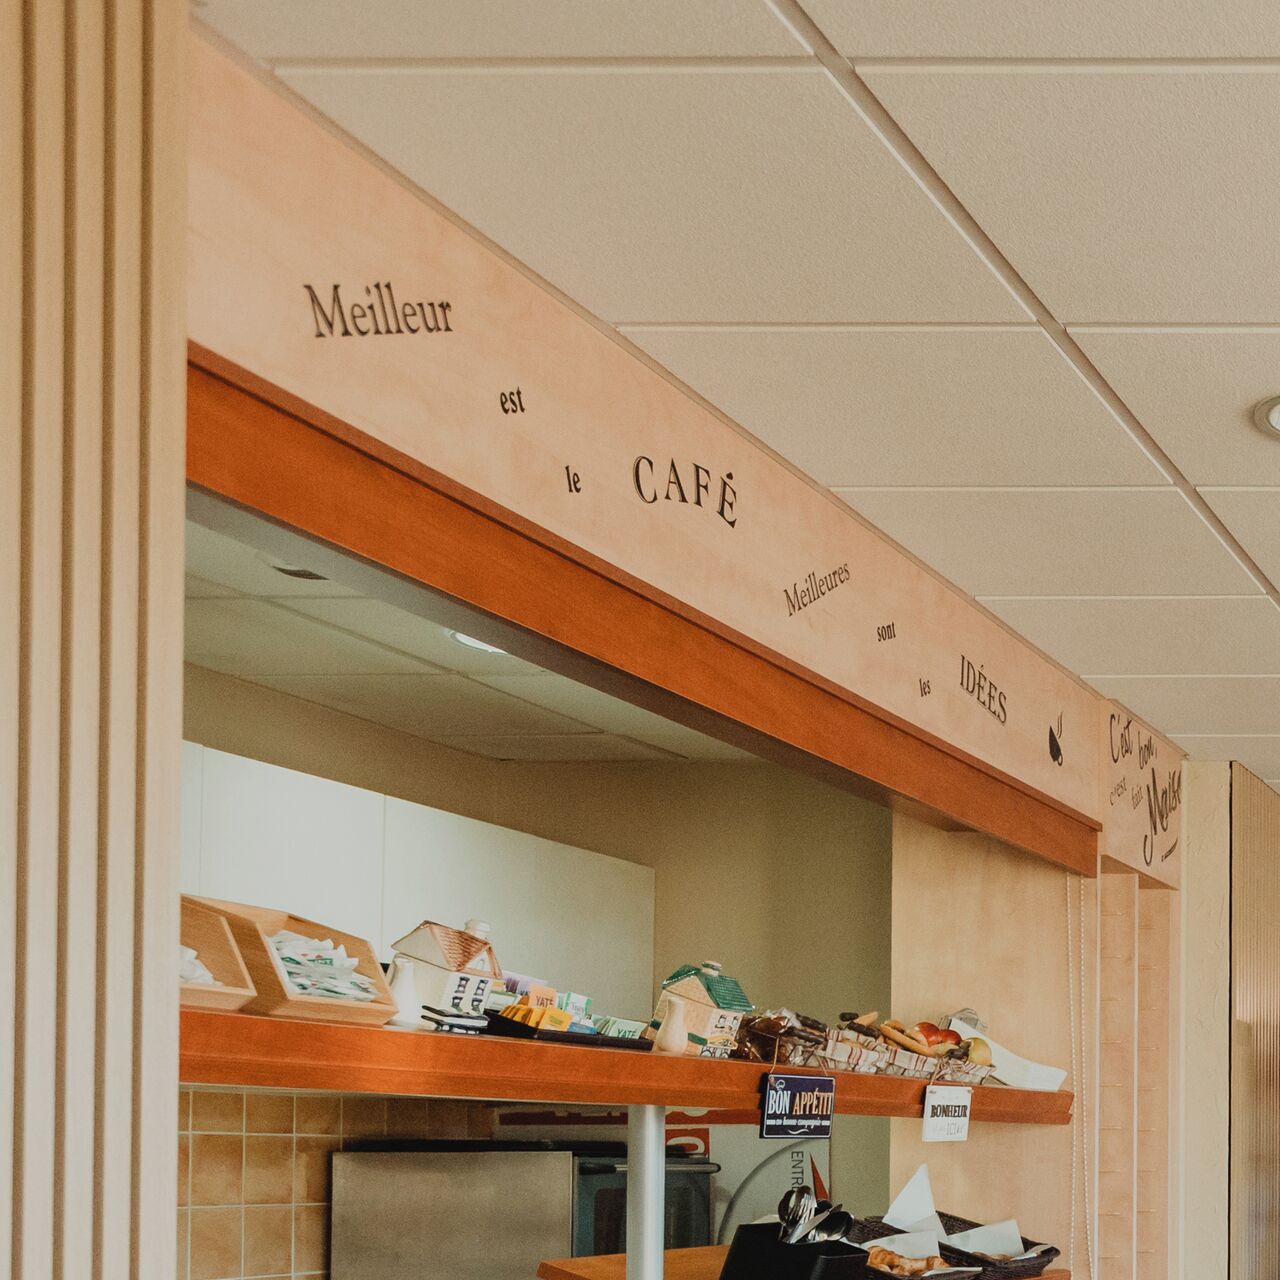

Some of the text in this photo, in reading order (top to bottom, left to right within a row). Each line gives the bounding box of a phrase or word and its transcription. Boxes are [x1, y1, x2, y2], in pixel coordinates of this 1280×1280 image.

[304, 281, 738, 530] Meilleur est le CAFÉ
[782, 561, 1009, 726] Meilleures sont les IDÉES
[767, 1087, 833, 1115] BON APPÉTIT
[930, 1104, 969, 1118] BONHEUR
